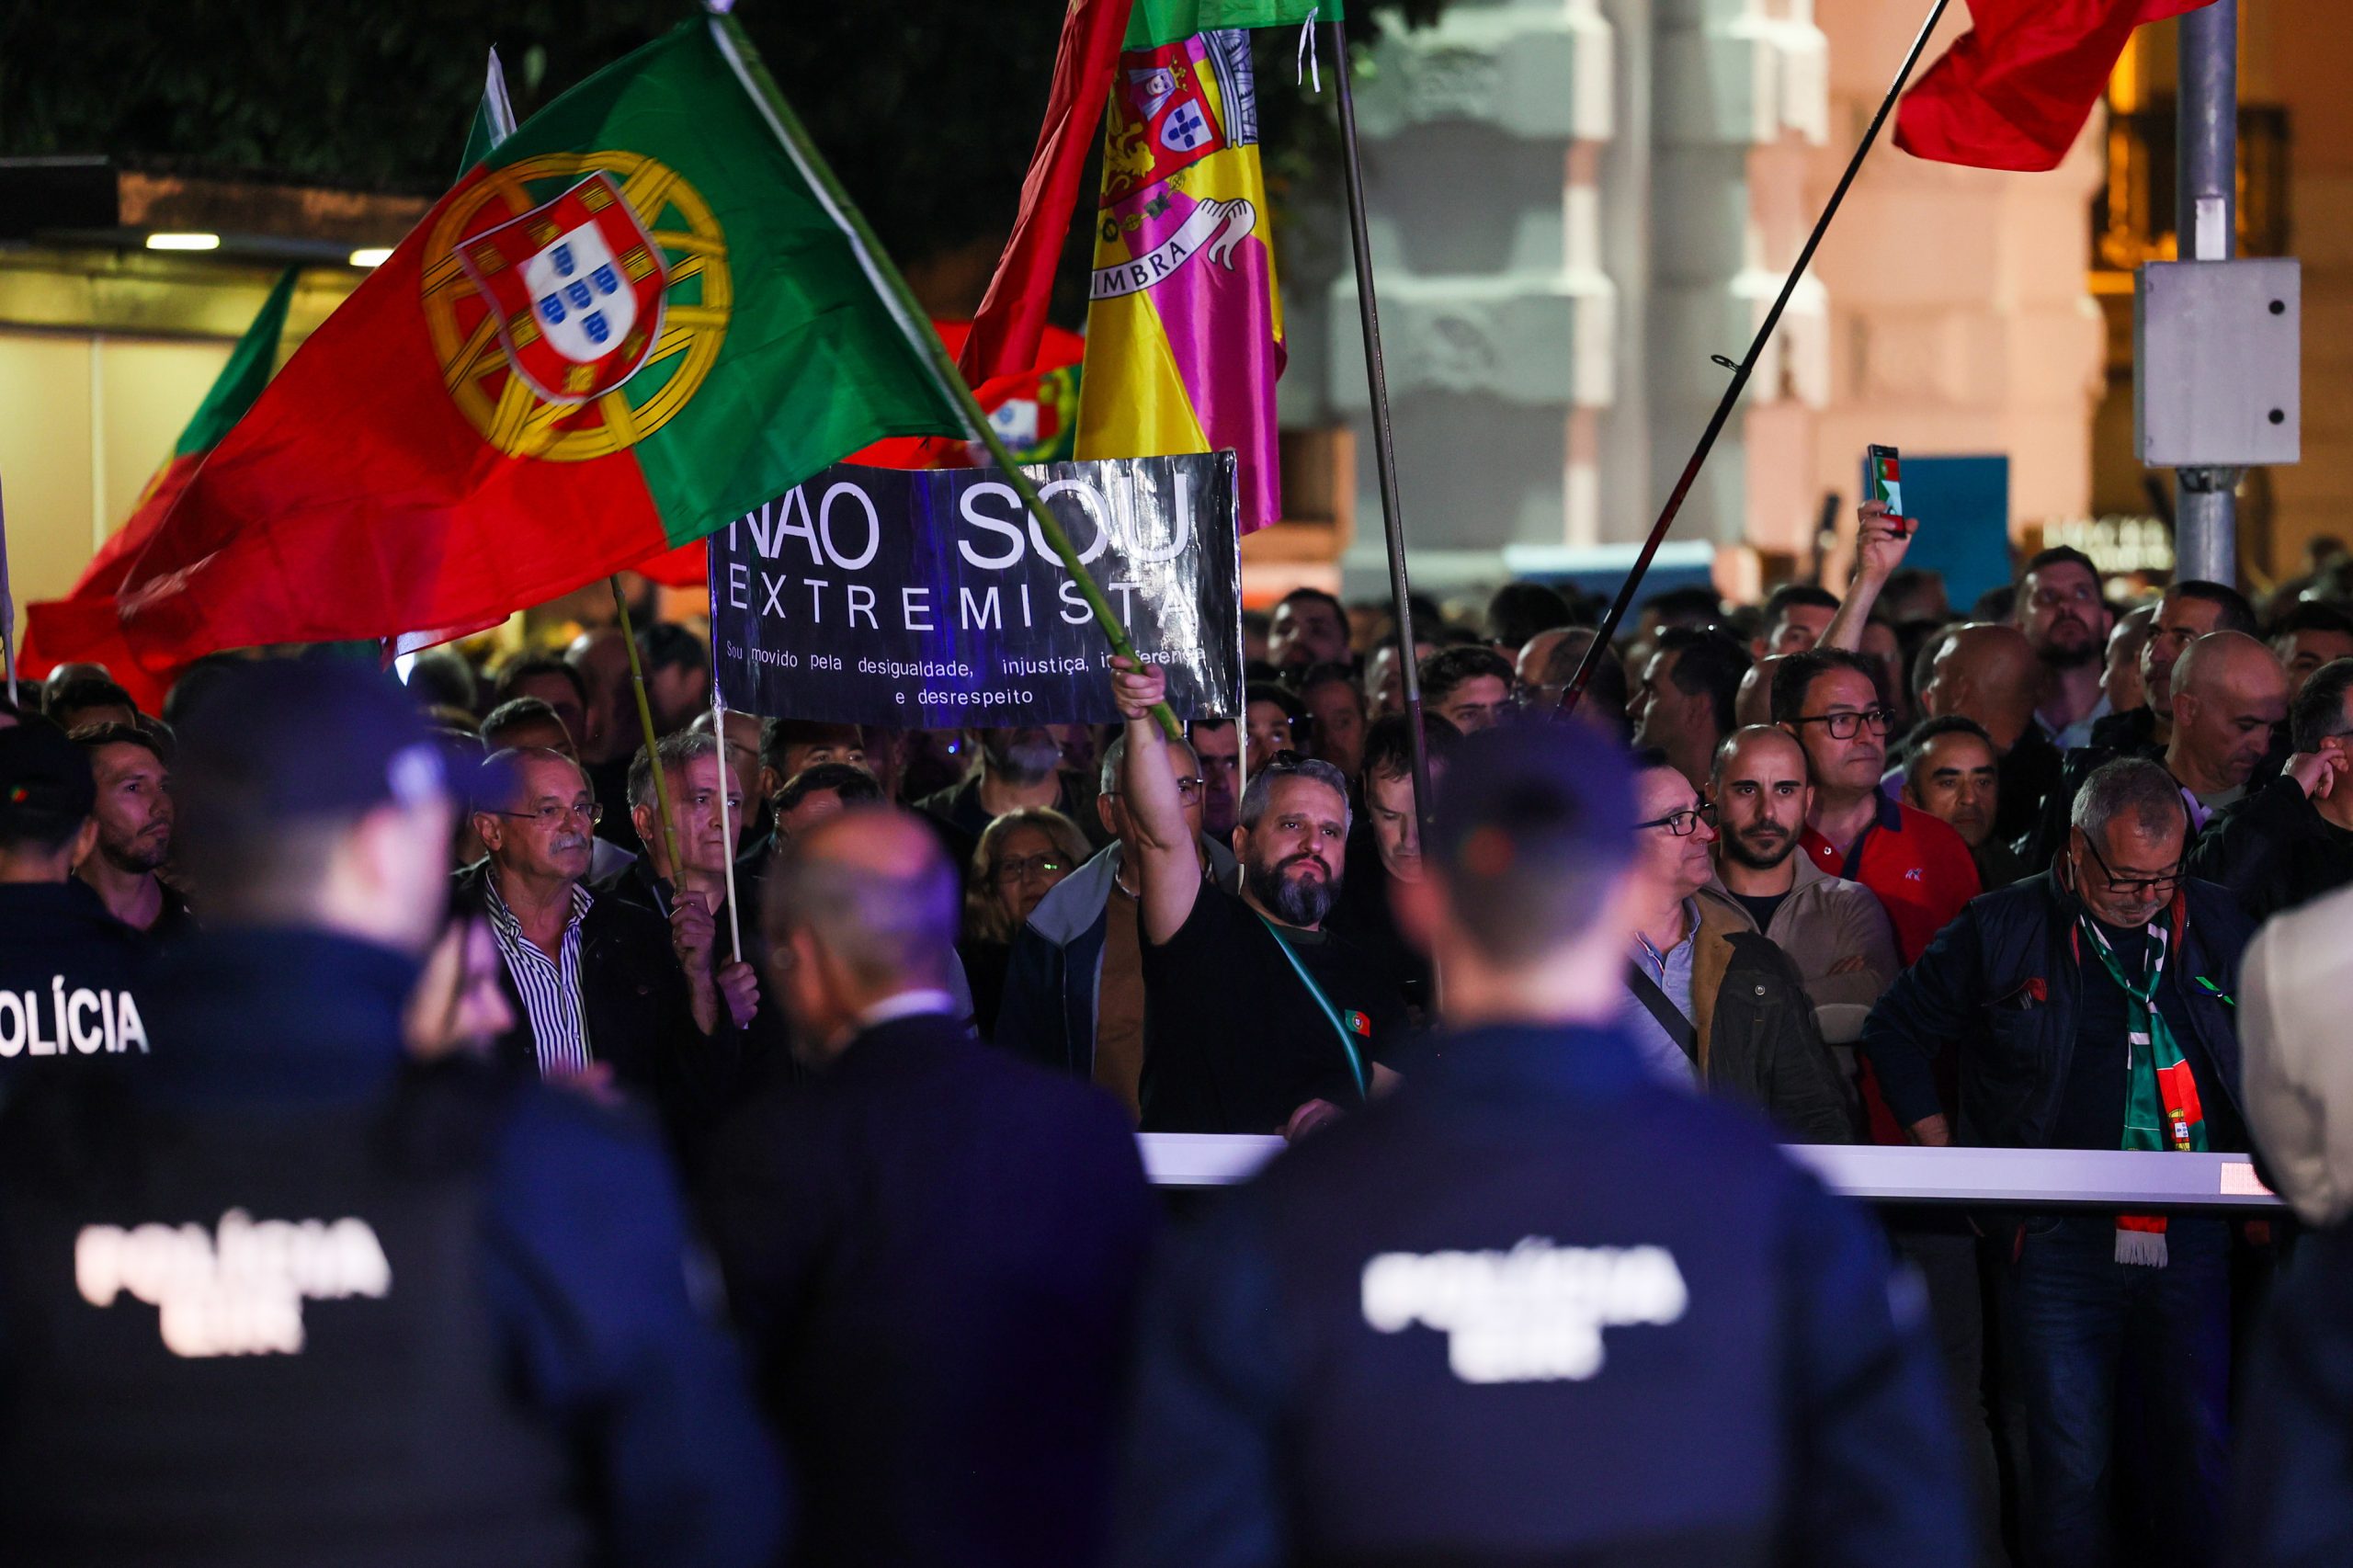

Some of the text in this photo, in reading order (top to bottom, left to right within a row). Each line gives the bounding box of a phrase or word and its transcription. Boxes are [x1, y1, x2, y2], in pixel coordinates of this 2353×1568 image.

[1094, 241, 1187, 295] IMBRA
[957, 472, 1189, 570] SOU
[729, 562, 1198, 631] EXTREMISTA
[726, 641, 1206, 679] Sou movido pela desigualdade, injustiça, inerença
[895, 688, 1033, 708] e desrespeito
[0, 974, 150, 1057] OLÍCIA
